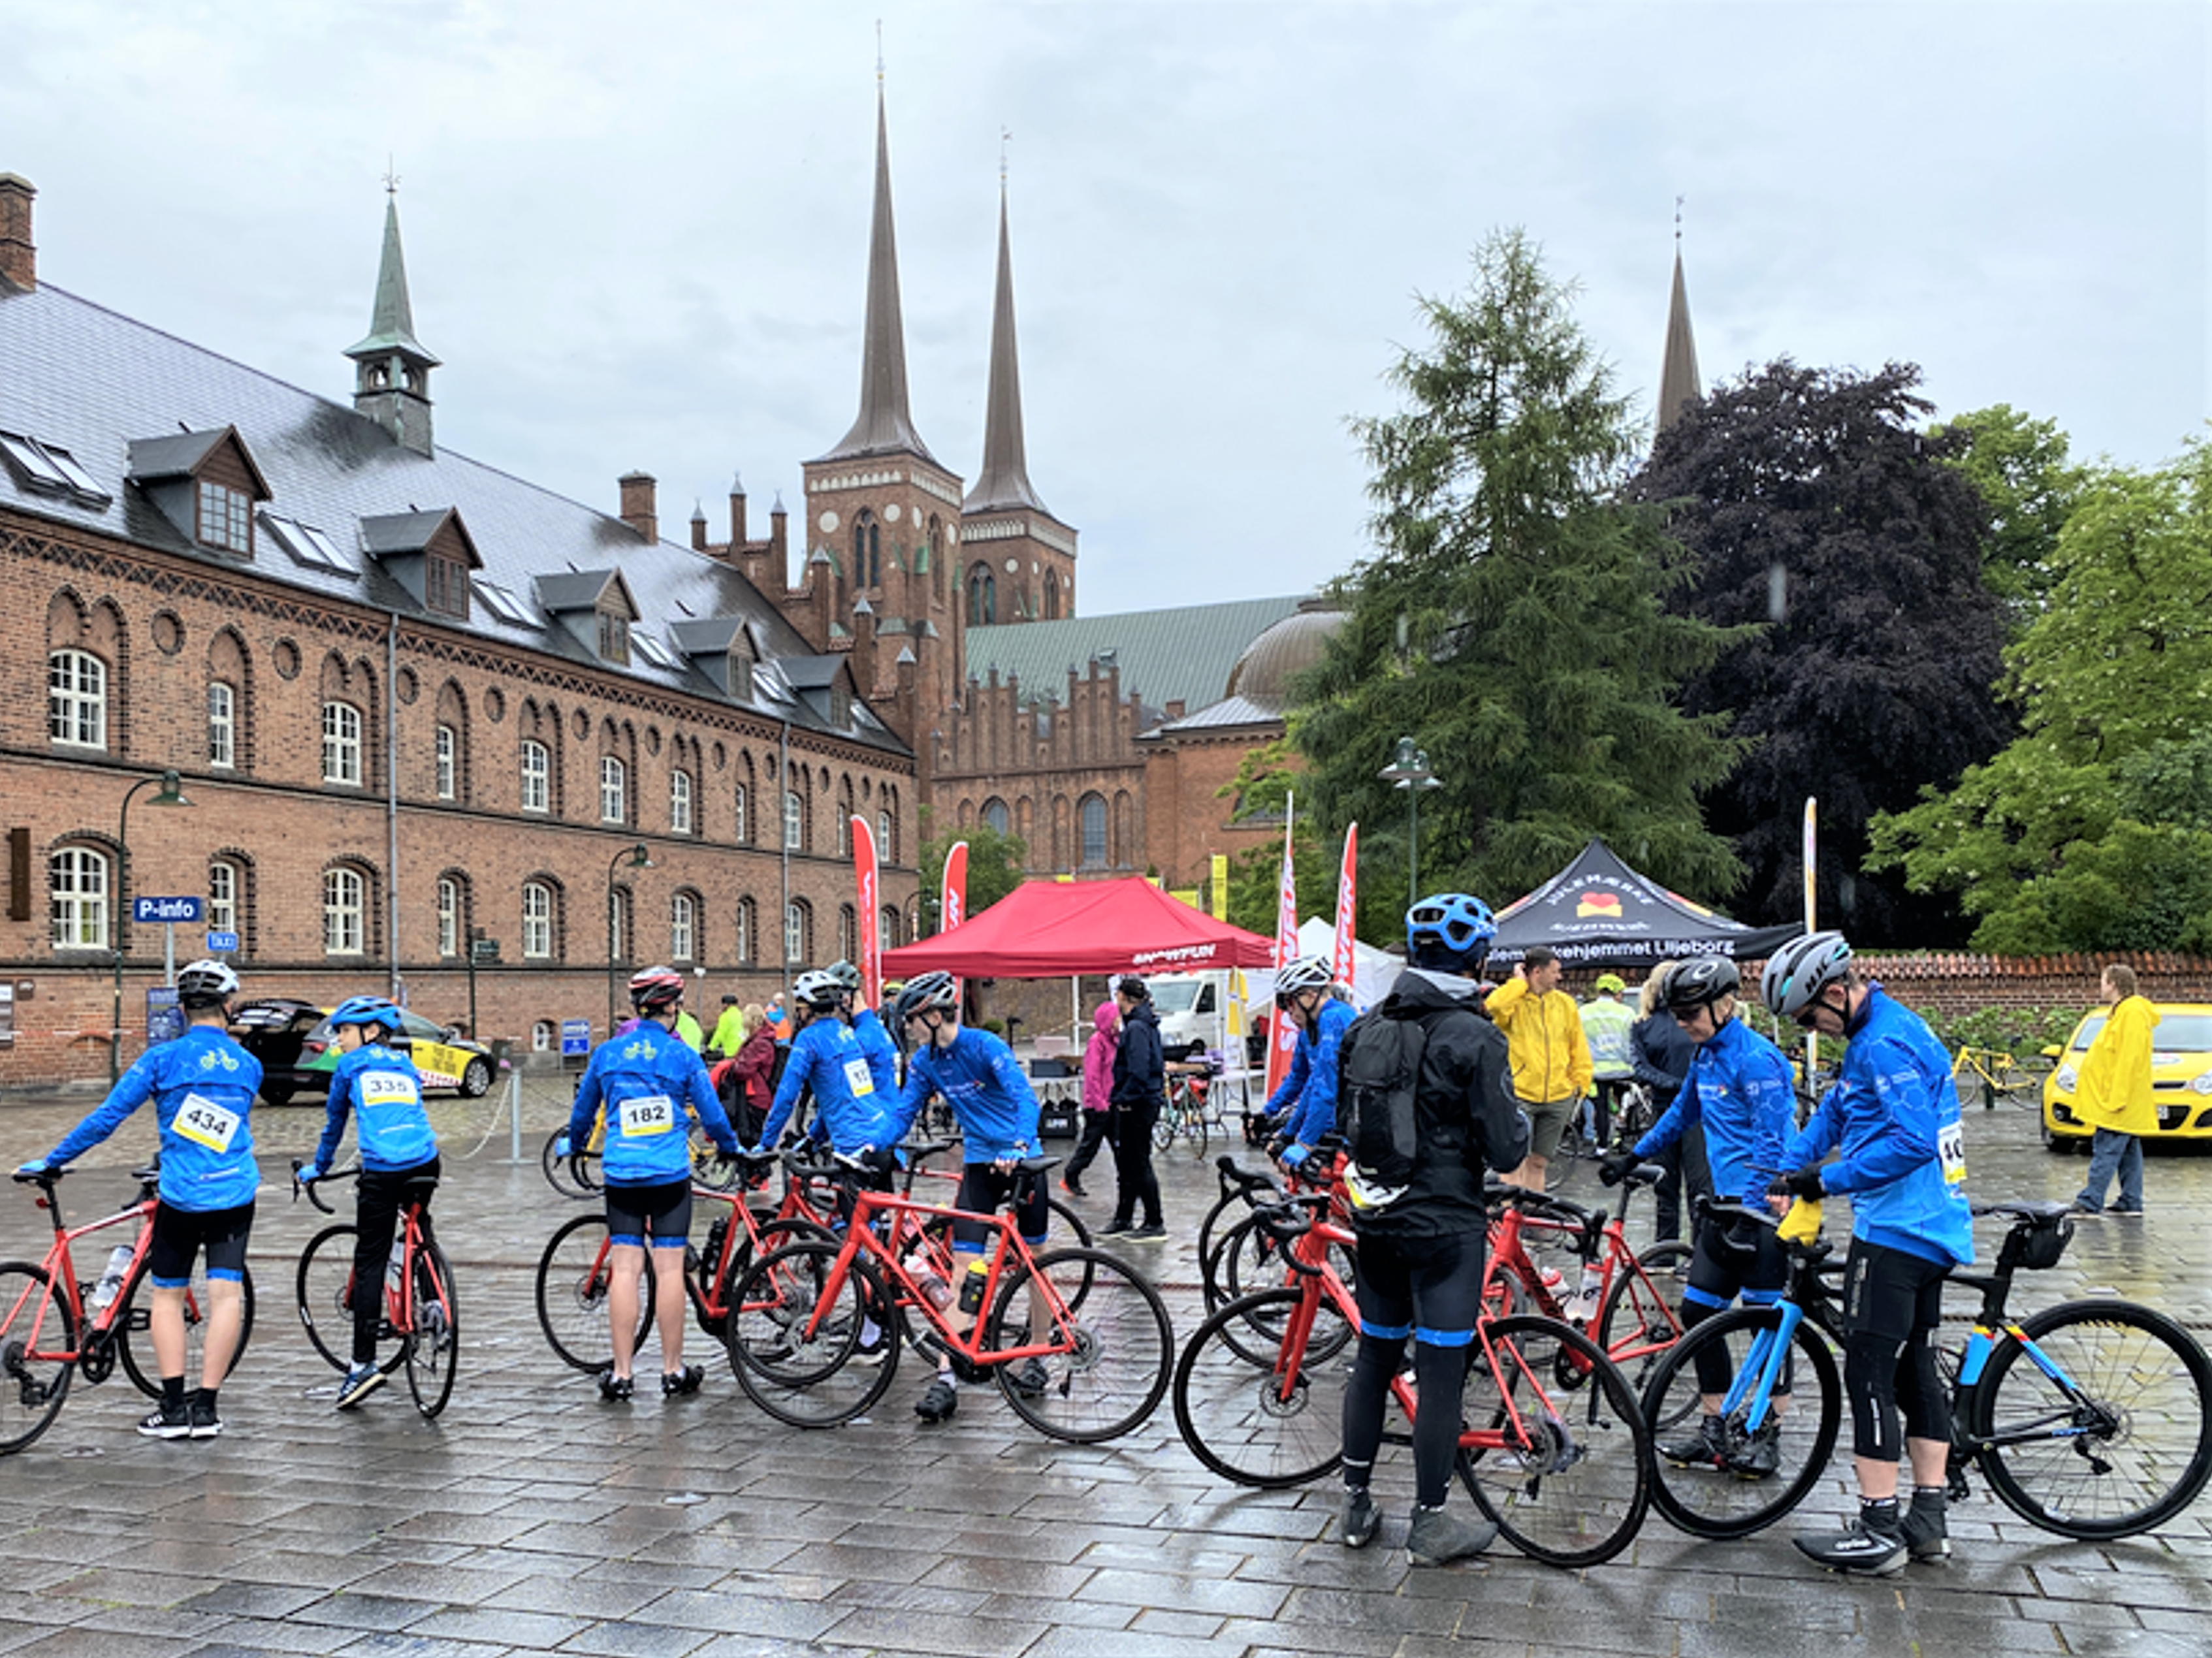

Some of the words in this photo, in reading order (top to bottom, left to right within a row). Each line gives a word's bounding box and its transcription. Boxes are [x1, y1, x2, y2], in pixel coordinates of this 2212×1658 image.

[139, 899, 195, 918] P-info
[1279, 854, 1301, 1051] SNWFUN
[1654, 940, 1735, 958] Liljeborg
[187, 1109, 227, 1135] 434
[629, 1105, 665, 1123] 182
